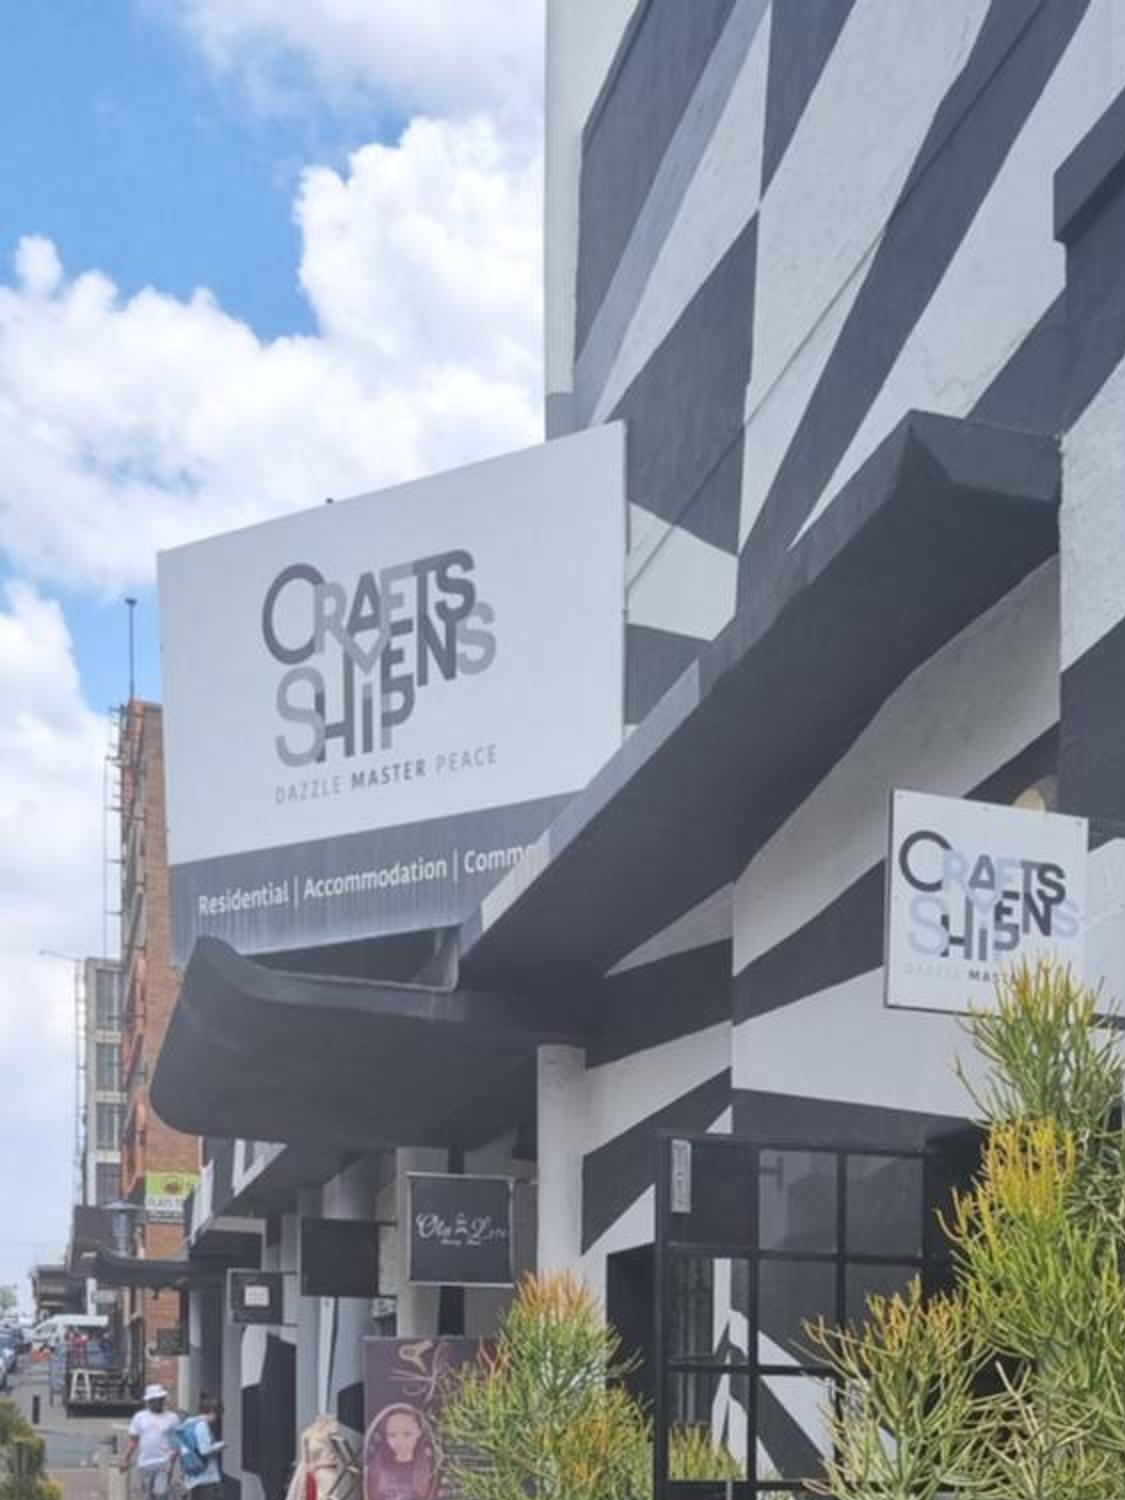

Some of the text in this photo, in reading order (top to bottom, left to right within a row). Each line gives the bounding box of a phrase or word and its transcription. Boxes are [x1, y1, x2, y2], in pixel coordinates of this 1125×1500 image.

[275, 744, 497, 804] DAZZLE MASTER PEACE
[198, 879, 290, 916] Residential
[303, 857, 447, 900] Accommodation
